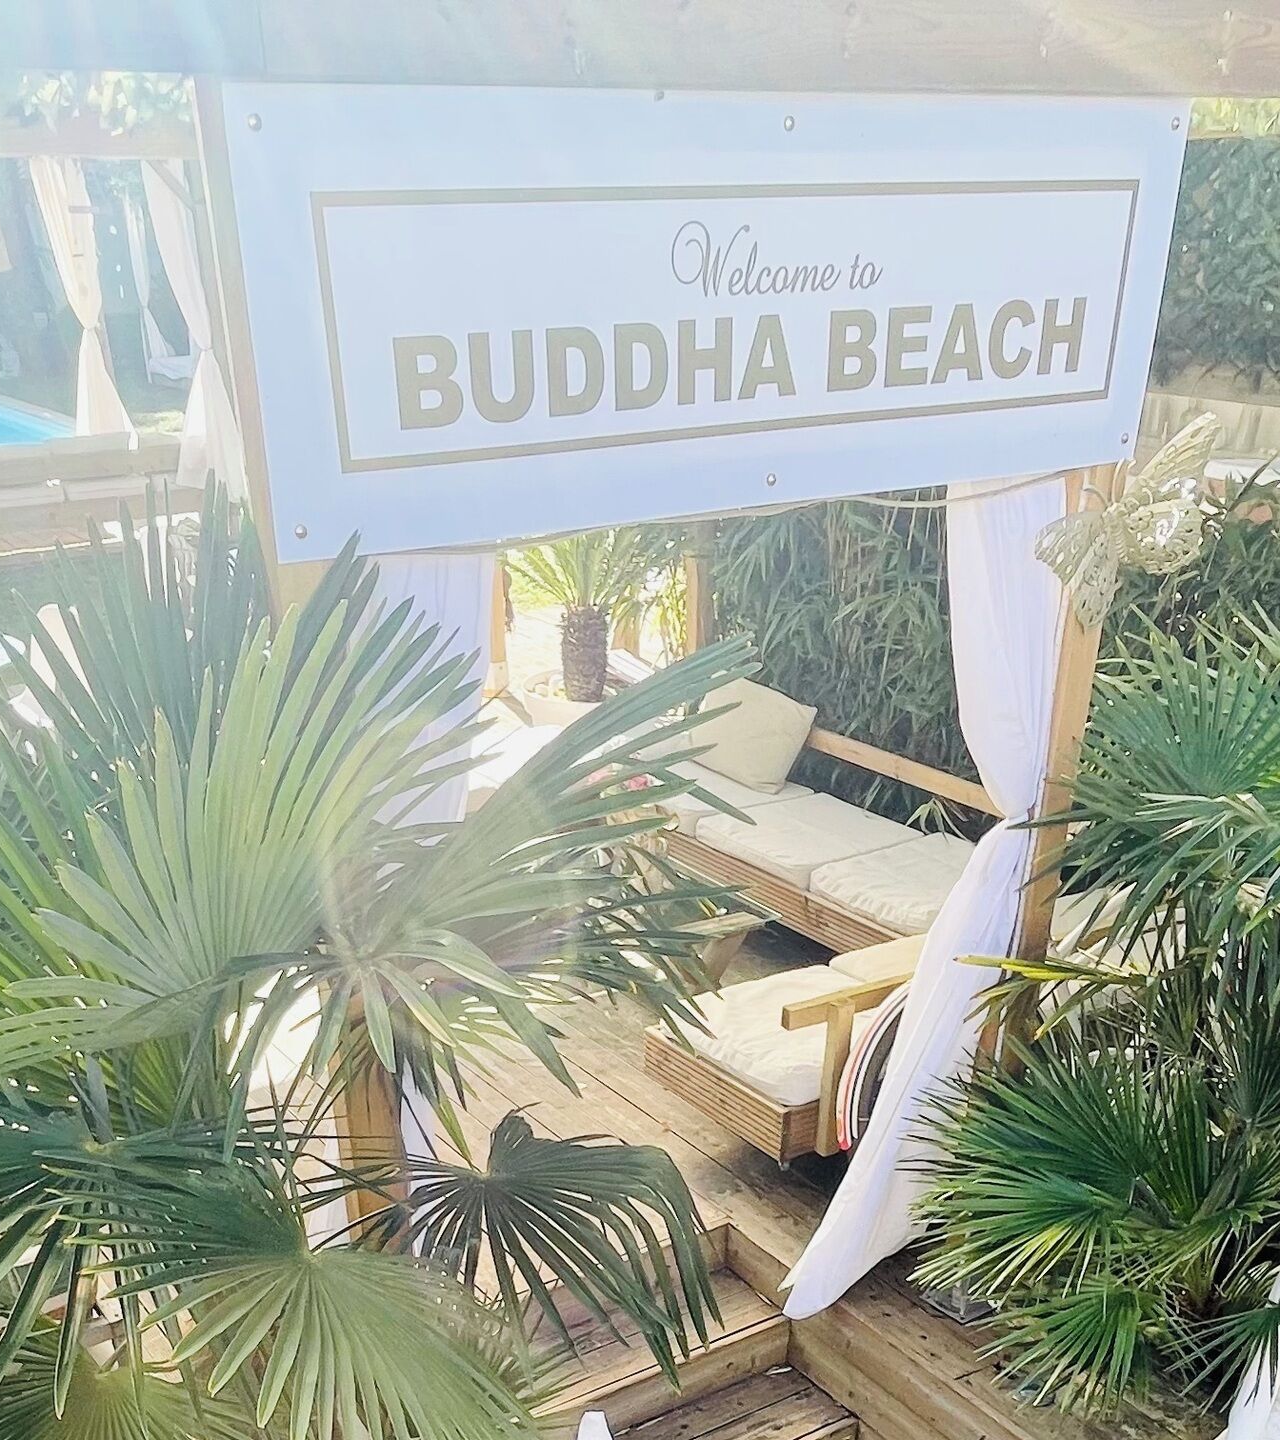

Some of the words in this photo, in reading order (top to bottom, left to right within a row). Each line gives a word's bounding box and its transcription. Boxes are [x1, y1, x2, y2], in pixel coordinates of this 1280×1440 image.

[671, 220, 842, 298] Welcome
[848, 253, 883, 290] to
[392, 313, 797, 431] BUDDHA
[826, 296, 1088, 393] BEACH
